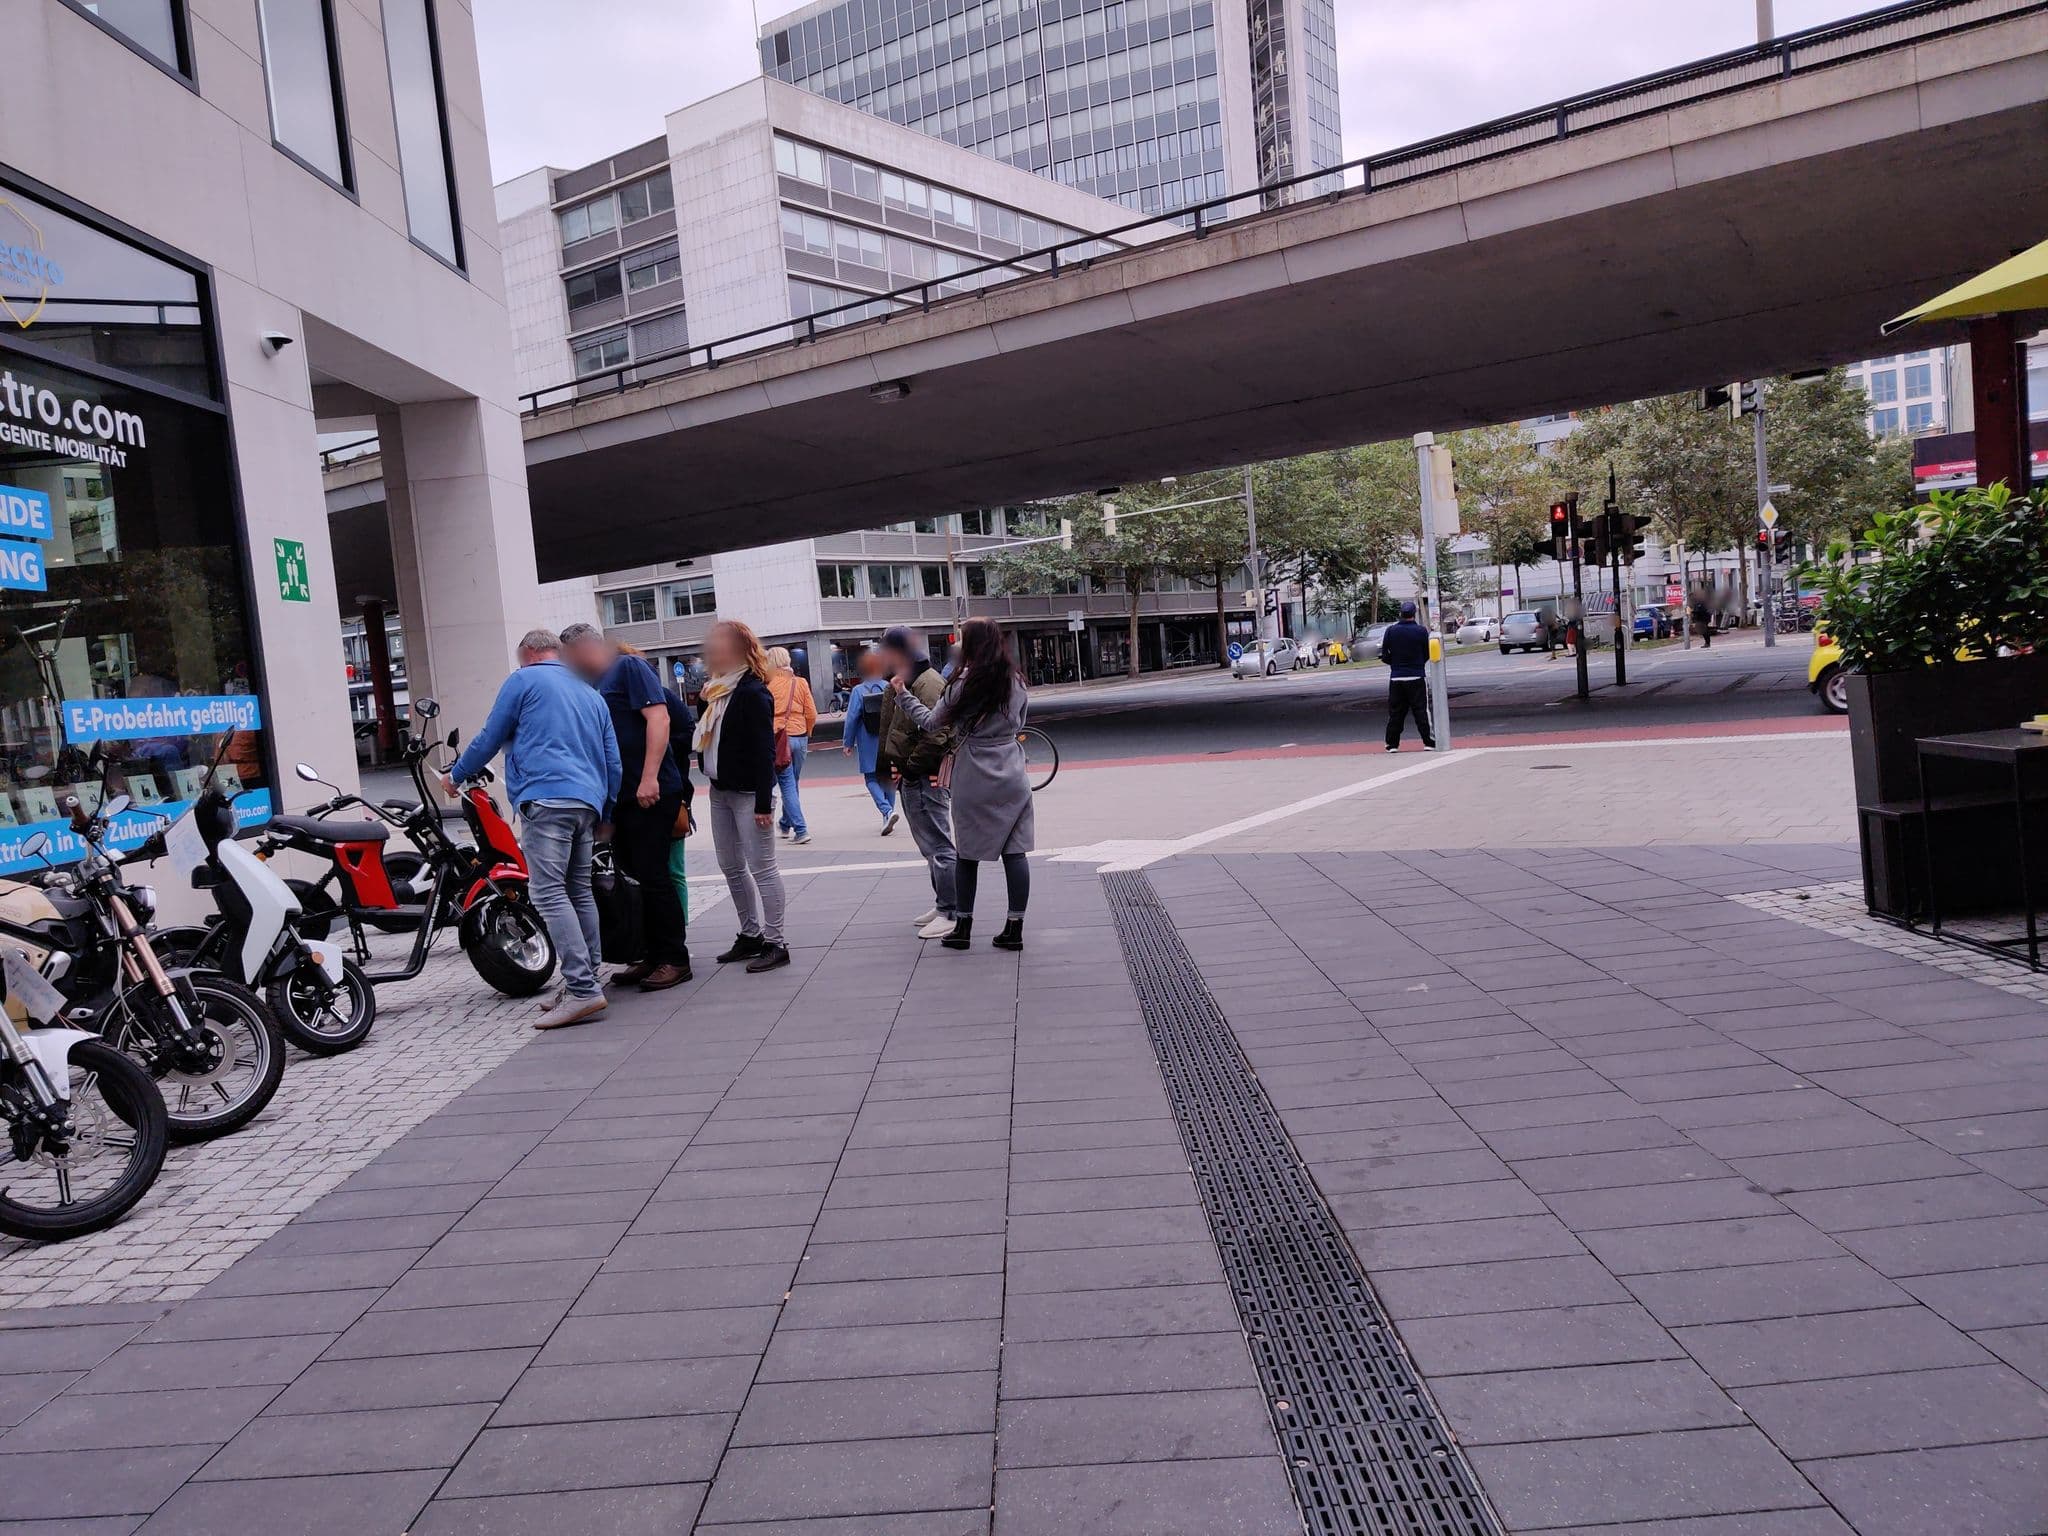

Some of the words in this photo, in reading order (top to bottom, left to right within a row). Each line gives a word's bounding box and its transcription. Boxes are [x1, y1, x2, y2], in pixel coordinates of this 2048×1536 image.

[54, 435, 127, 468] MOBILITÄT
[71, 703, 188, 734] E-Probefahrt
[190, 700, 254, 731] gefällig?
[56, 830, 74, 852] in
